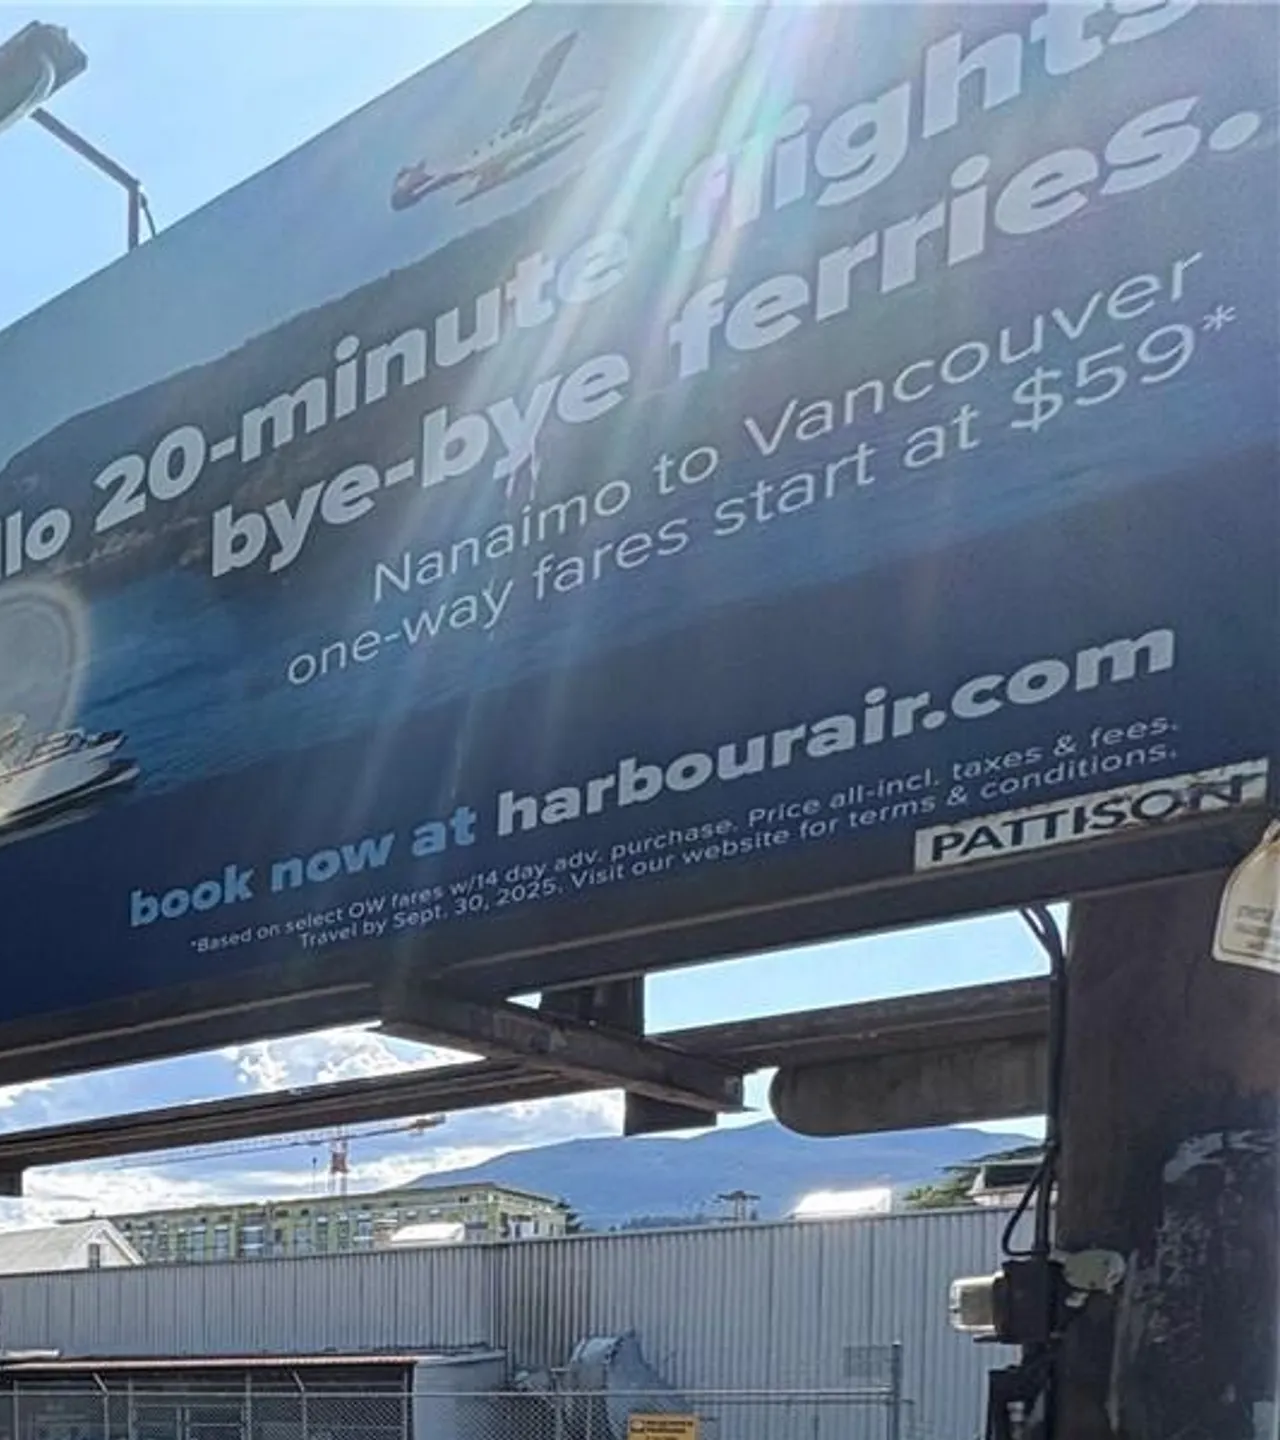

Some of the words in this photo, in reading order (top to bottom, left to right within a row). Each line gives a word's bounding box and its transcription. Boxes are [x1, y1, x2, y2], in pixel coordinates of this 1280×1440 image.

[94, 230, 629, 533] 20-minute
[211, 353, 630, 577] bye-bye
[668, 96, 1261, 379] ferries.
[373, 479, 631, 603] Nanaimo
[653, 445, 719, 495] to
[744, 252, 1204, 457] Vancouver
[287, 578, 514, 685] one-way
[533, 517, 690, 600] fares
[713, 442, 876, 536] start
[903, 403, 980, 469] at
[129, 864, 255, 928] book
[270, 833, 395, 893] now
[411, 805, 477, 857] at
[496, 627, 1175, 837] harbourair.com
[256, 924, 281, 940] on
[286, 907, 343, 931] select
[347, 896, 386, 919] OW
[391, 885, 443, 910] fares
[449, 870, 498, 899] w/14
[505, 859, 545, 883] day
[554, 849, 602, 872] adv.
[610, 819, 739, 862] purchase.
[748, 798, 821, 828] Price
[828, 768, 939, 811] all-incl.
[952, 747, 1044, 780] taxes
[1053, 734, 1077, 756] &
[1090, 717, 1180, 748] fees.
[299, 926, 358, 950] Travel
[362, 918, 388, 938] by
[393, 906, 449, 930] Sept.
[454, 893, 490, 916] 30,
[496, 877, 564, 904] 2025.
[569, 863, 625, 889] Visit
[631, 854, 676, 876] our
[682, 829, 790, 865] website
[799, 817, 841, 840] for
[848, 796, 936, 828] terms
[946, 784, 970, 807] &
[979, 743, 1178, 799] conditions.
[932, 773, 1244, 862] PATTISON
